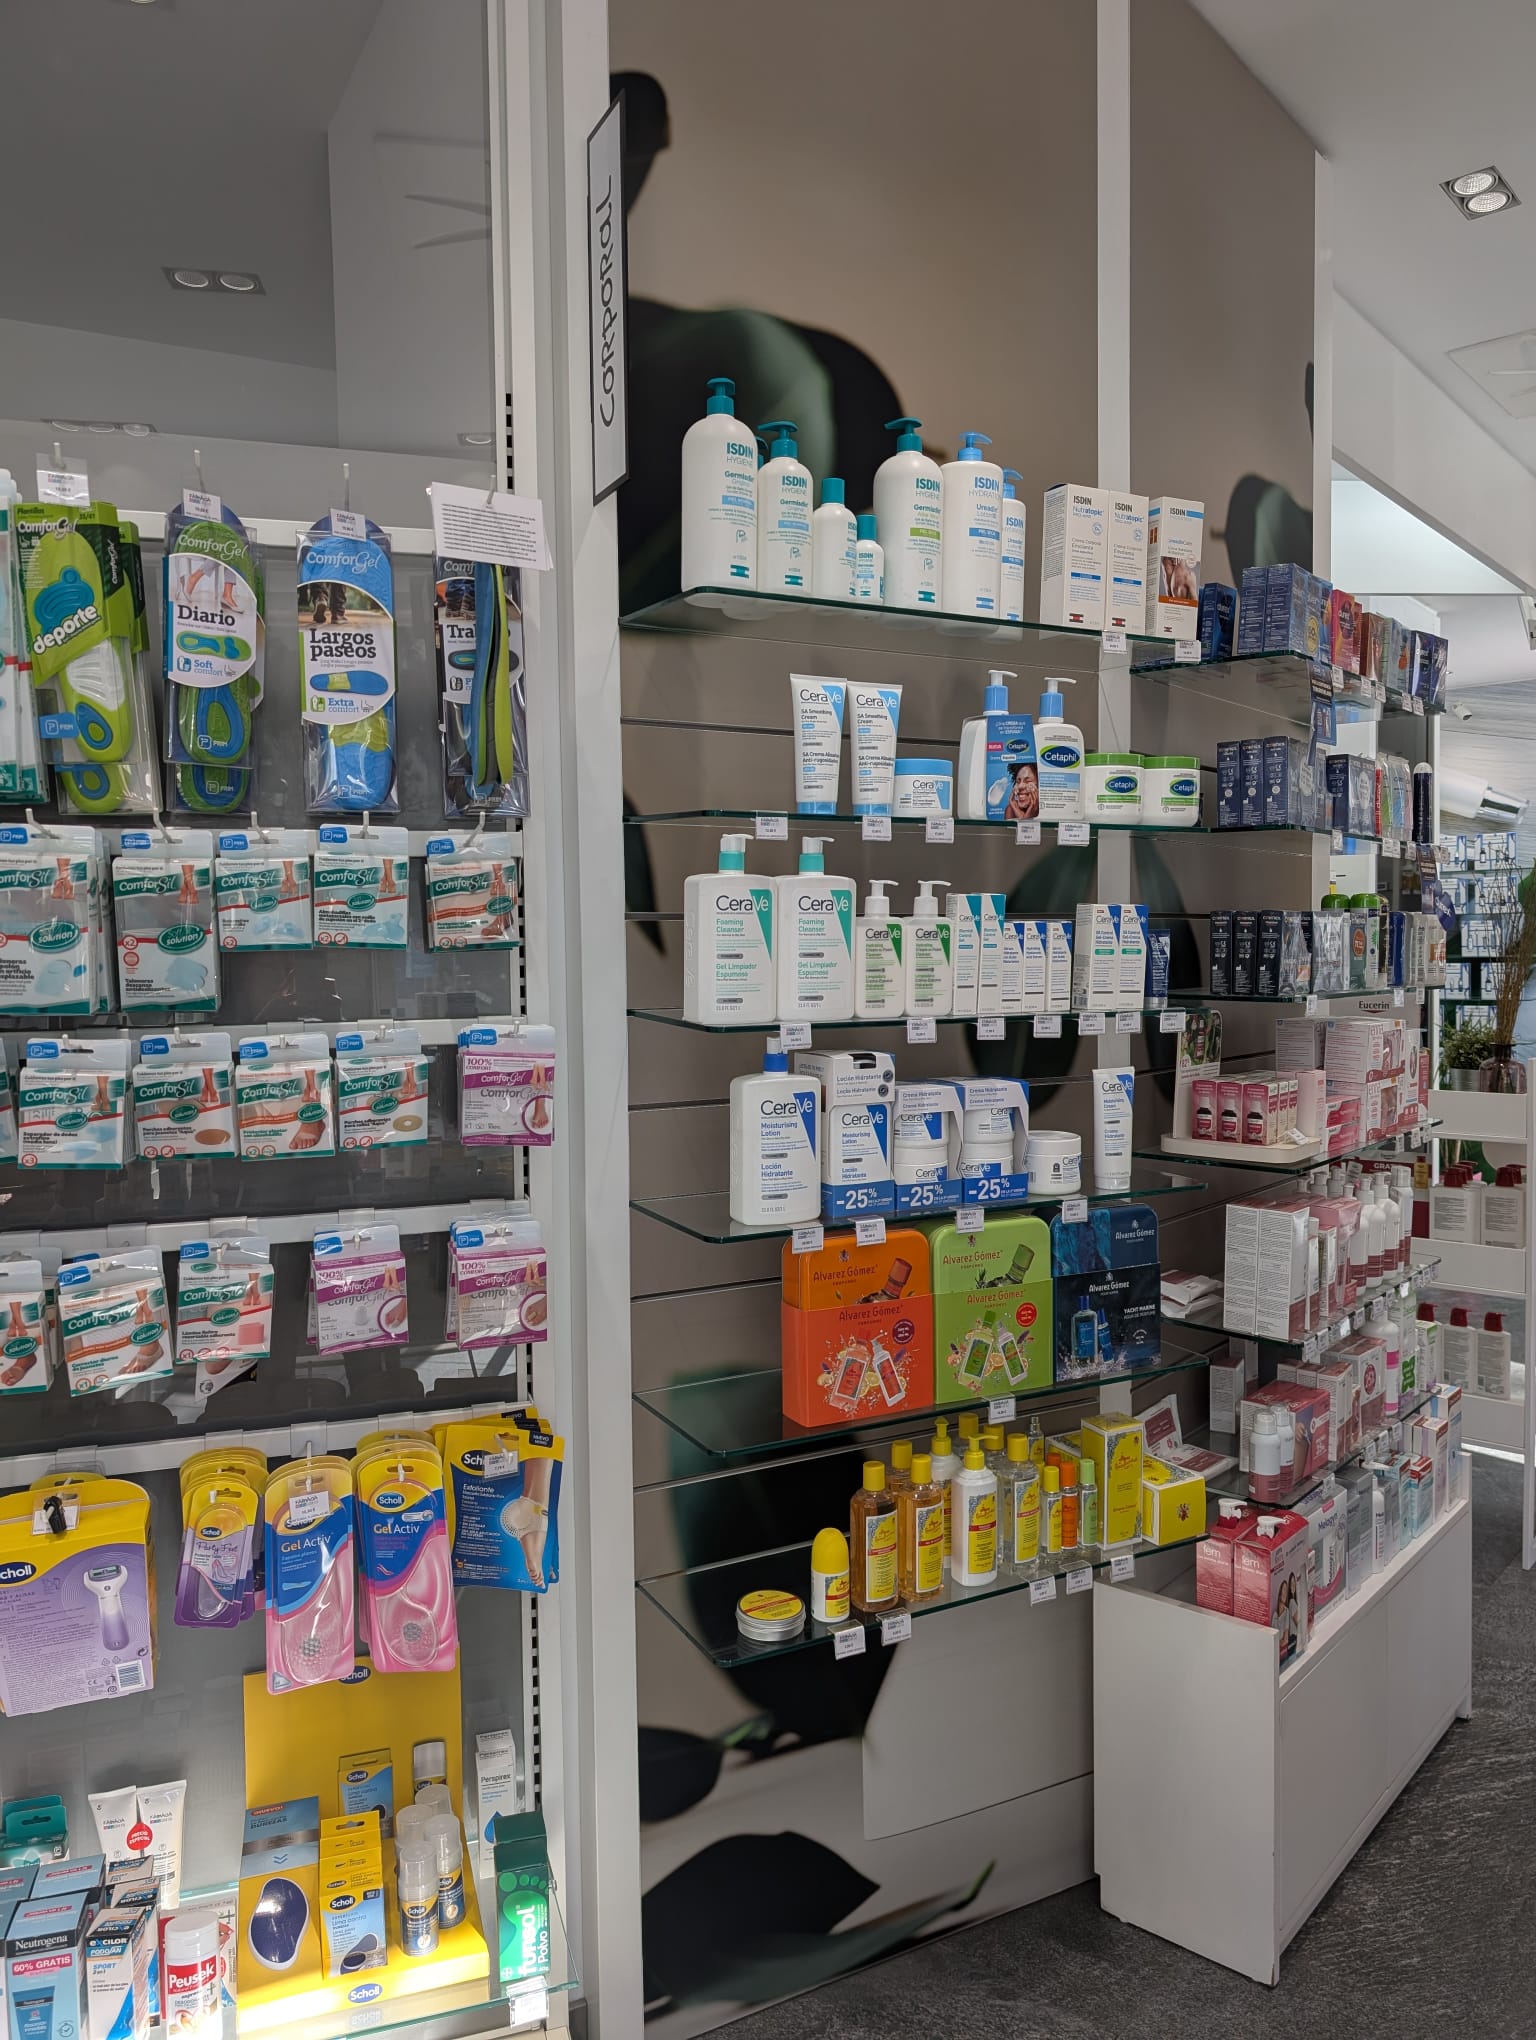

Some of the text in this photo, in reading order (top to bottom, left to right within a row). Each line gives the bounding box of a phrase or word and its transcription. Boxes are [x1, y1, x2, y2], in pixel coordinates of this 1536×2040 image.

[727, 442, 753, 459] ISDIN
[782, 475, 808, 489] ISDIN
[915, 477, 941, 492] ISDIN
[974, 476, 1000, 492] ISDIN
[1073, 496, 1092, 506] ISDIN
[1115, 502, 1133, 513] ISDIN
[1169, 508, 1186, 517] ISDIN
[18, 517, 79, 541] ComforGel
[1006, 516, 1024, 529] ISDIN
[178, 534, 249, 560] ComforGel
[306, 551, 382, 574] ComforGel
[177, 605, 236, 626] Diario
[33, 603, 98, 655] deporte
[309, 628, 374, 652] Largos
[310, 645, 377, 661] paseos
[193, 659, 213, 669] Soft
[328, 698, 354, 707] Extra
[800, 689, 842, 704] CeraVe
[856, 694, 897, 708] CeraVe
[1008, 743, 1027, 752] Cetaphil
[1044, 752, 1077, 763] Cetaphil
[912, 779, 944, 790] CeraVe
[1108, 780, 1136, 791] Cetaphil
[0, 868, 50, 888] omforSil
[221, 870, 275, 891] ComforSil
[319, 868, 375, 887] ComforSil
[119, 875, 176, 894] ComforSil
[715, 895, 769, 912] CeraVe
[798, 895, 849, 912] CeraVe
[716, 918, 744, 926] Foaming
[798, 918, 825, 926] Foaming
[1095, 916, 1120, 924] CeraVe
[1122, 915, 1147, 924] CeraVe
[38, 930, 74, 944] solution
[865, 928, 901, 939] CeraVe
[915, 928, 950, 939] CeraVe
[716, 962, 757, 971] Gel Limpiador
[810, 961, 838, 970] Limpiador
[716, 970, 749, 979] Espumoso
[798, 969, 829, 977] Espumoso
[1358, 1001, 1390, 1010] Eucerin
[467, 1058, 492, 1066] 100%
[344, 1072, 398, 1090] ComforSil
[481, 1072, 526, 1086] ComforGel
[139, 1080, 193, 1098] ComforSil
[242, 1080, 297, 1099] ComforSil
[1102, 1081, 1132, 1093] CeraVe
[25, 1086, 88, 1104] ComforSil
[760, 1098, 813, 1116] CeraVe
[842, 1111, 884, 1126] CeraVe
[761, 1121, 798, 1130] Moisturising
[761, 1162, 782, 1170] Loción
[915, 1167, 944, 1178] CeraVe
[961, 1163, 991, 1173] CeraVe
[761, 1169, 794, 1178] Hidratante
[1115, 1228, 1155, 1240] Alvarez Gómez
[943, 1250, 1001, 1265] Alvarez Gómez
[460, 1262, 486, 1271] 100%
[475, 1271, 520, 1287] ComforGel
[814, 1265, 875, 1283] Alvarez Gómez
[1089, 1281, 1130, 1293] Alvarez Gómez
[967, 1289, 1024, 1304] Alvarez Gómez
[839, 1305, 900, 1321] Alvarez Gómez
[463, 1483, 495, 1493] Exfoliante
[379, 1496, 403, 1505] Scholl
[202, 1528, 221, 1536] Scholl
[373, 1522, 420, 1534] Gel Activ
[281, 1533, 332, 1552] Gel Activ
[347, 1771, 367, 1782] Scholl
[480, 1773, 511, 1784] Perspirex
[331, 1895, 354, 1908] Scholl
[407, 1905, 426, 1915] Scholl
[15, 1934, 69, 1950] Neutrogena
[518, 1905, 536, 1977] funsol
[538, 1929, 549, 1964] Polvo
[13, 1956, 71, 1973] 60% GRATIS
[169, 1960, 215, 1988] Peusek
[349, 1986, 380, 2000] Scholl
